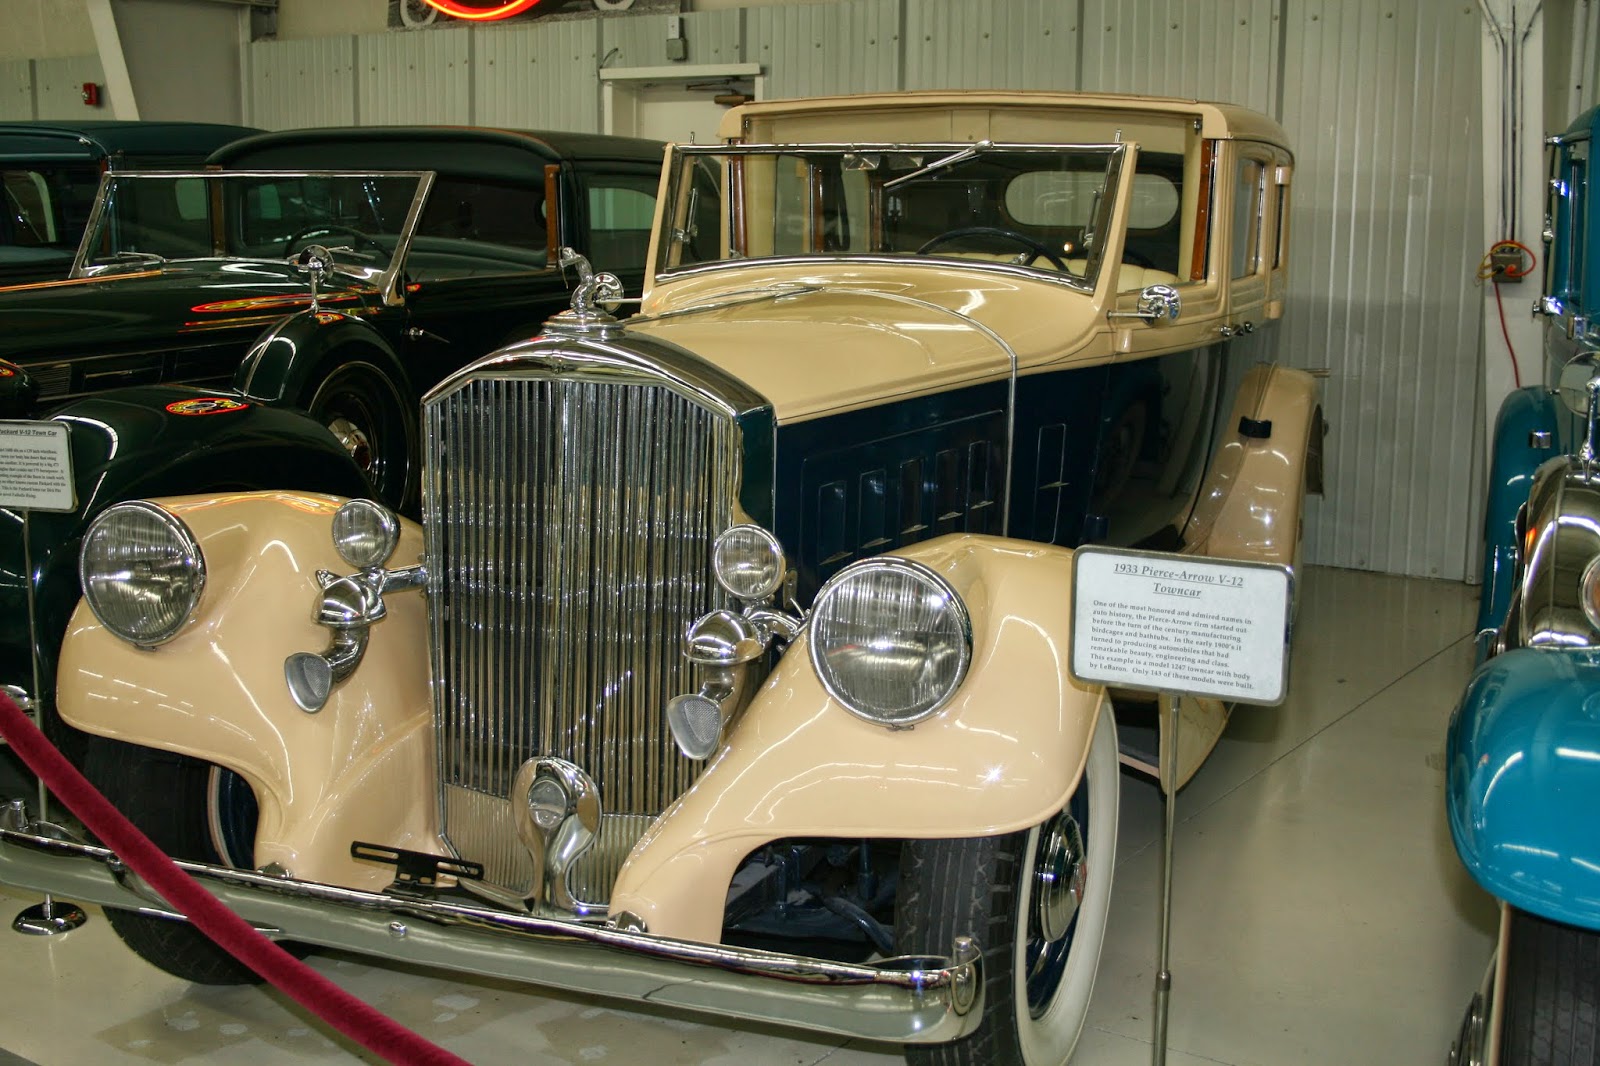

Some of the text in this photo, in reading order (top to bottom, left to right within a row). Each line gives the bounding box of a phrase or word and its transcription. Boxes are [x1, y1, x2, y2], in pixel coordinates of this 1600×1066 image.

[1114, 563, 1244, 587] 1933 Pierce-Arrow V-12
[1153, 582, 1202, 597] Towncar
[1109, 611, 1134, 620] history,
[1148, 615, 1192, 626] Pierce-Arrow
[1194, 620, 1209, 628] firm
[1211, 623, 1234, 632] started
[1147, 606, 1176, 615] honored
[1191, 612, 1220, 620] admired
[1221, 616, 1243, 624] names
[1091, 626, 1123, 636] birdcages
[1139, 632, 1170, 641] bathtubs.
[1196, 640, 1213, 648] early
[1215, 642, 1235, 650] 1900's
[1092, 618, 1114, 626] before
[1164, 626, 1189, 636] century
[1191, 630, 1241, 643] manufacturing
[1091, 645, 1128, 654] remarkable
[1129, 649, 1154, 658] beauty,
[1155, 653, 1196, 664] engineering
[1211, 660, 1230, 668] class.
[1123, 640, 1157, 650] producing
[1159, 644, 1200, 654] automobiles
[1106, 656, 1134, 664] example
[1187, 666, 1214, 674] towncar
[1233, 672, 1251, 681] body
[1132, 667, 1149, 675] Only
[1191, 676, 1216, 684] models
[1235, 681, 1254, 690] built.
